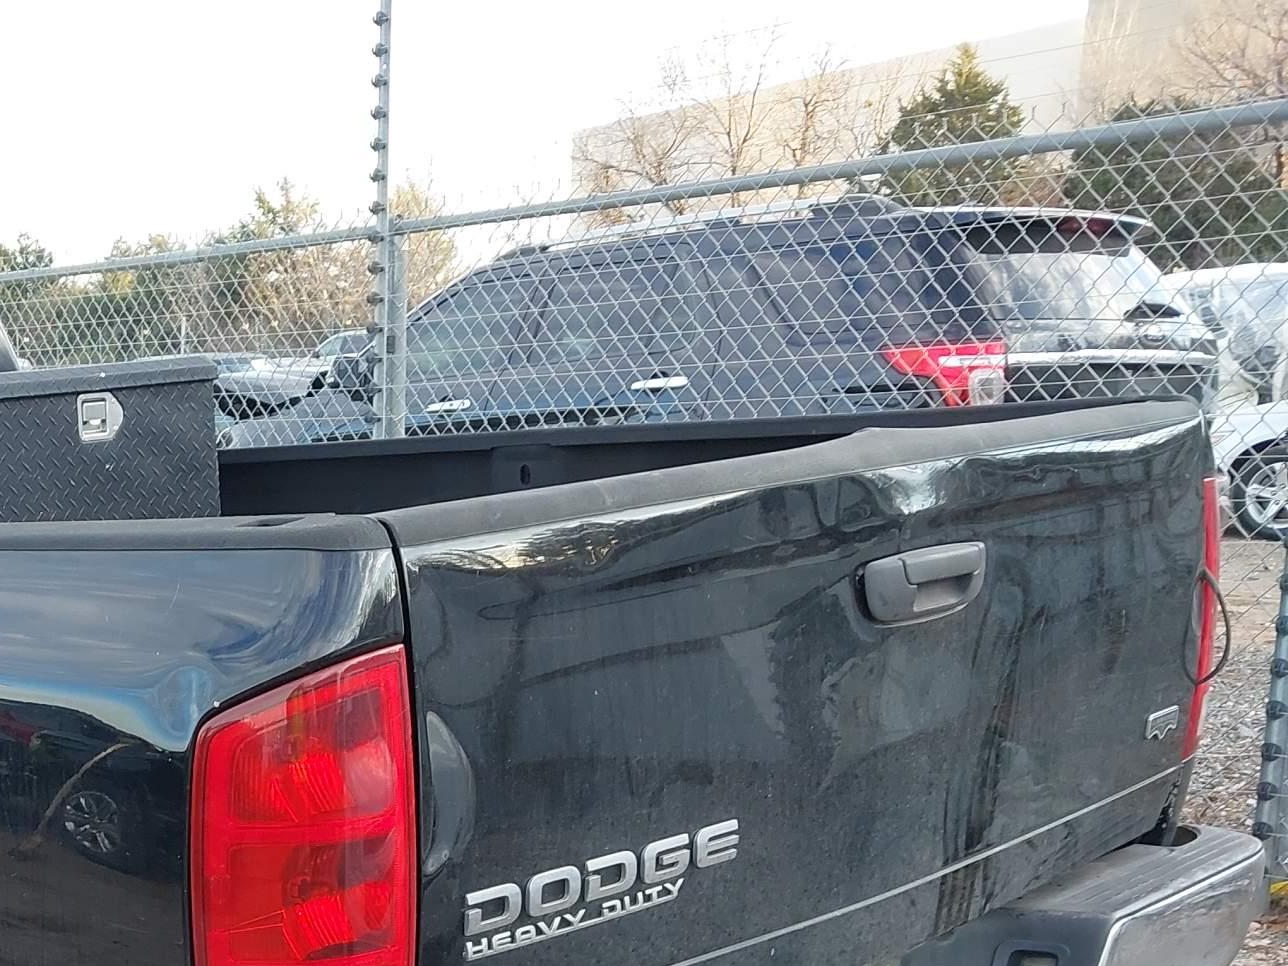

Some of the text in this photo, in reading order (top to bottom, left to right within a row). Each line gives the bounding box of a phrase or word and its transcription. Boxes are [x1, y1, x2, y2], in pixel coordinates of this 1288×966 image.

[464, 818, 740, 937] DODGE
[464, 878, 685, 961] HEAVY DUTY
